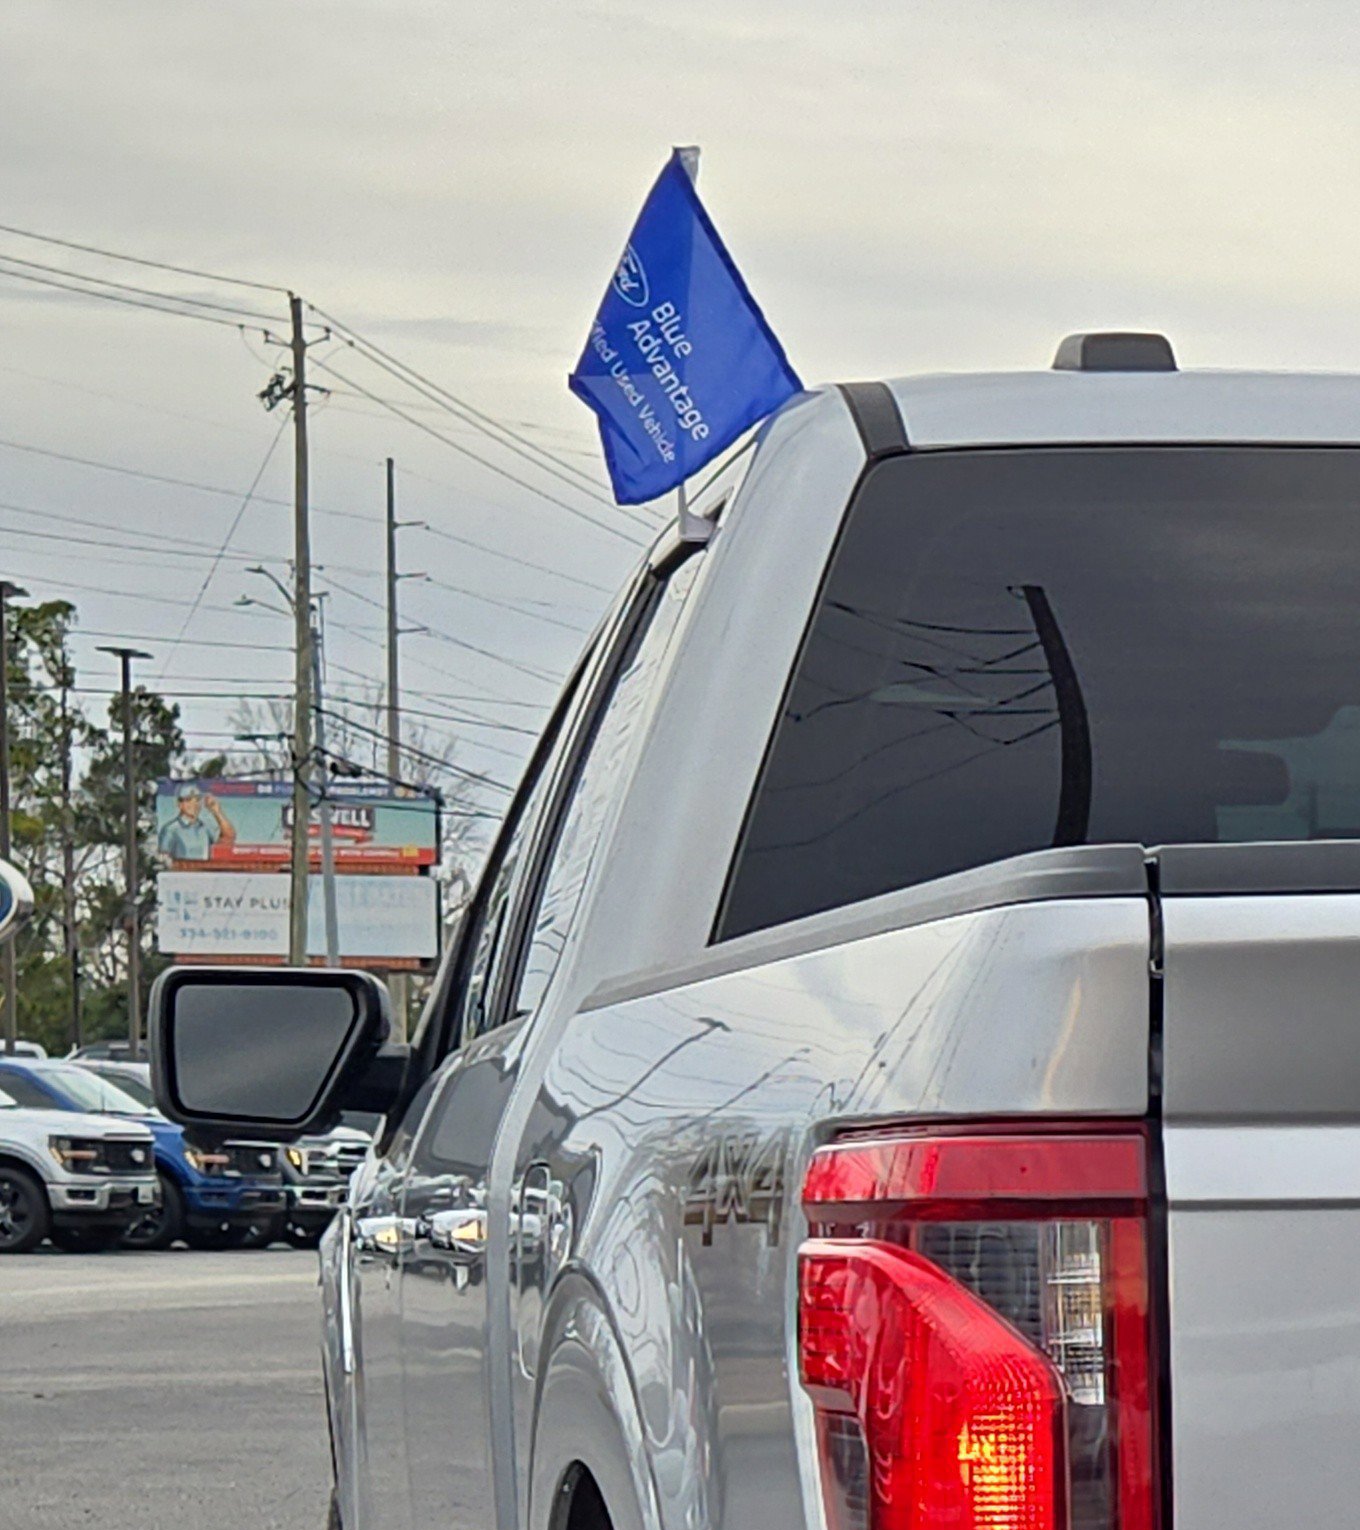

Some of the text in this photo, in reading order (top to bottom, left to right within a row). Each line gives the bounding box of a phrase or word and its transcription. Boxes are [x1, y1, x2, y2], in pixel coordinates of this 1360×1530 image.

[652, 301, 693, 358] Blue
[611, 359, 645, 407] Used
[638, 404, 676, 464] Vehicle
[627, 319, 710, 441] Advantage
[203, 896, 243, 909] STAY
